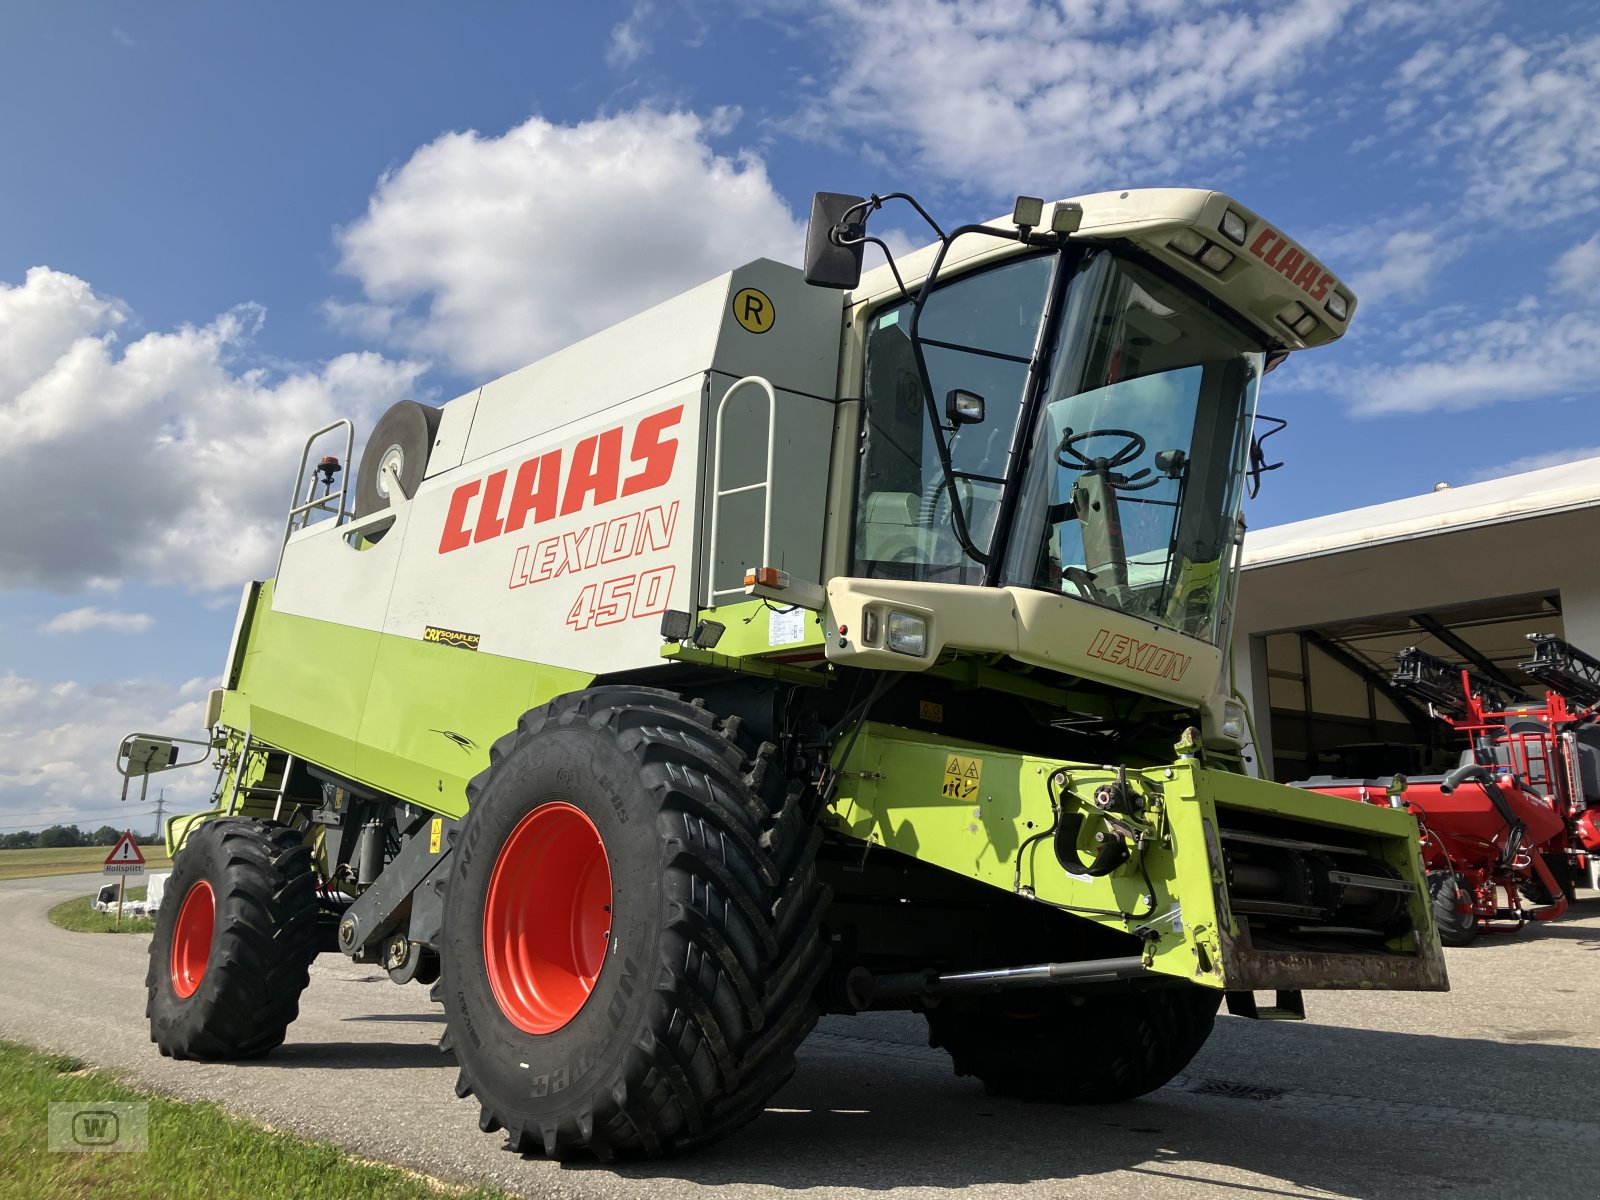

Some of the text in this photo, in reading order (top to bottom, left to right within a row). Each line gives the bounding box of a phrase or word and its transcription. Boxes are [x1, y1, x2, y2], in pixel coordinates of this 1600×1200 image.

[1249, 228, 1335, 302] CLAAS
[744, 294, 763, 326] R
[438, 404, 684, 555] CLAAS
[509, 500, 680, 589] LEXION
[566, 564, 676, 631] 450
[424, 628, 479, 642] CRX SOJAFLEX
[1086, 629, 1191, 681] LEXION
